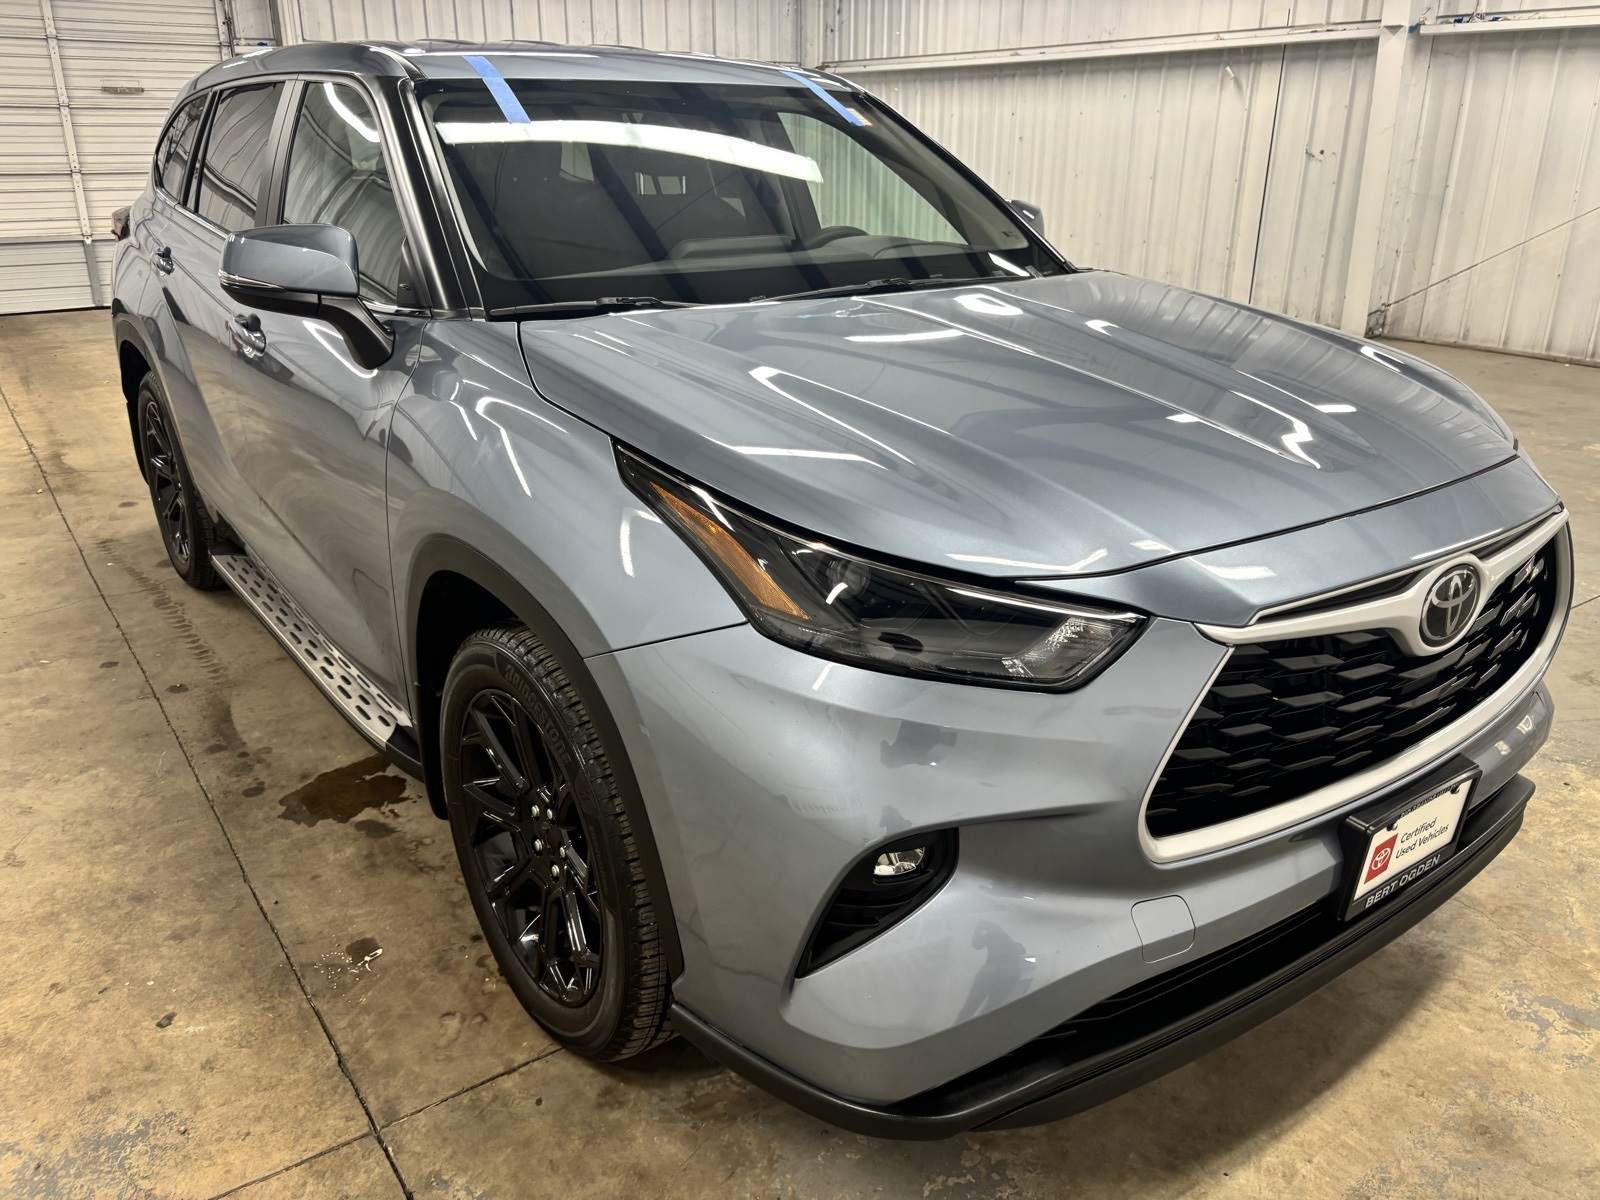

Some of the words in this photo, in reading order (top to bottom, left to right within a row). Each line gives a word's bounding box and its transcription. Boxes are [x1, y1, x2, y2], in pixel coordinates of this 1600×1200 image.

[504, 664, 573, 764] BRIDGESTONE
[1396, 839, 1418, 859] Used
[1418, 824, 1449, 847] Vehicles
[1401, 816, 1437, 843] Certified
[1365, 880, 1399, 908] BERT
[1399, 853, 1441, 887] OGDEN
